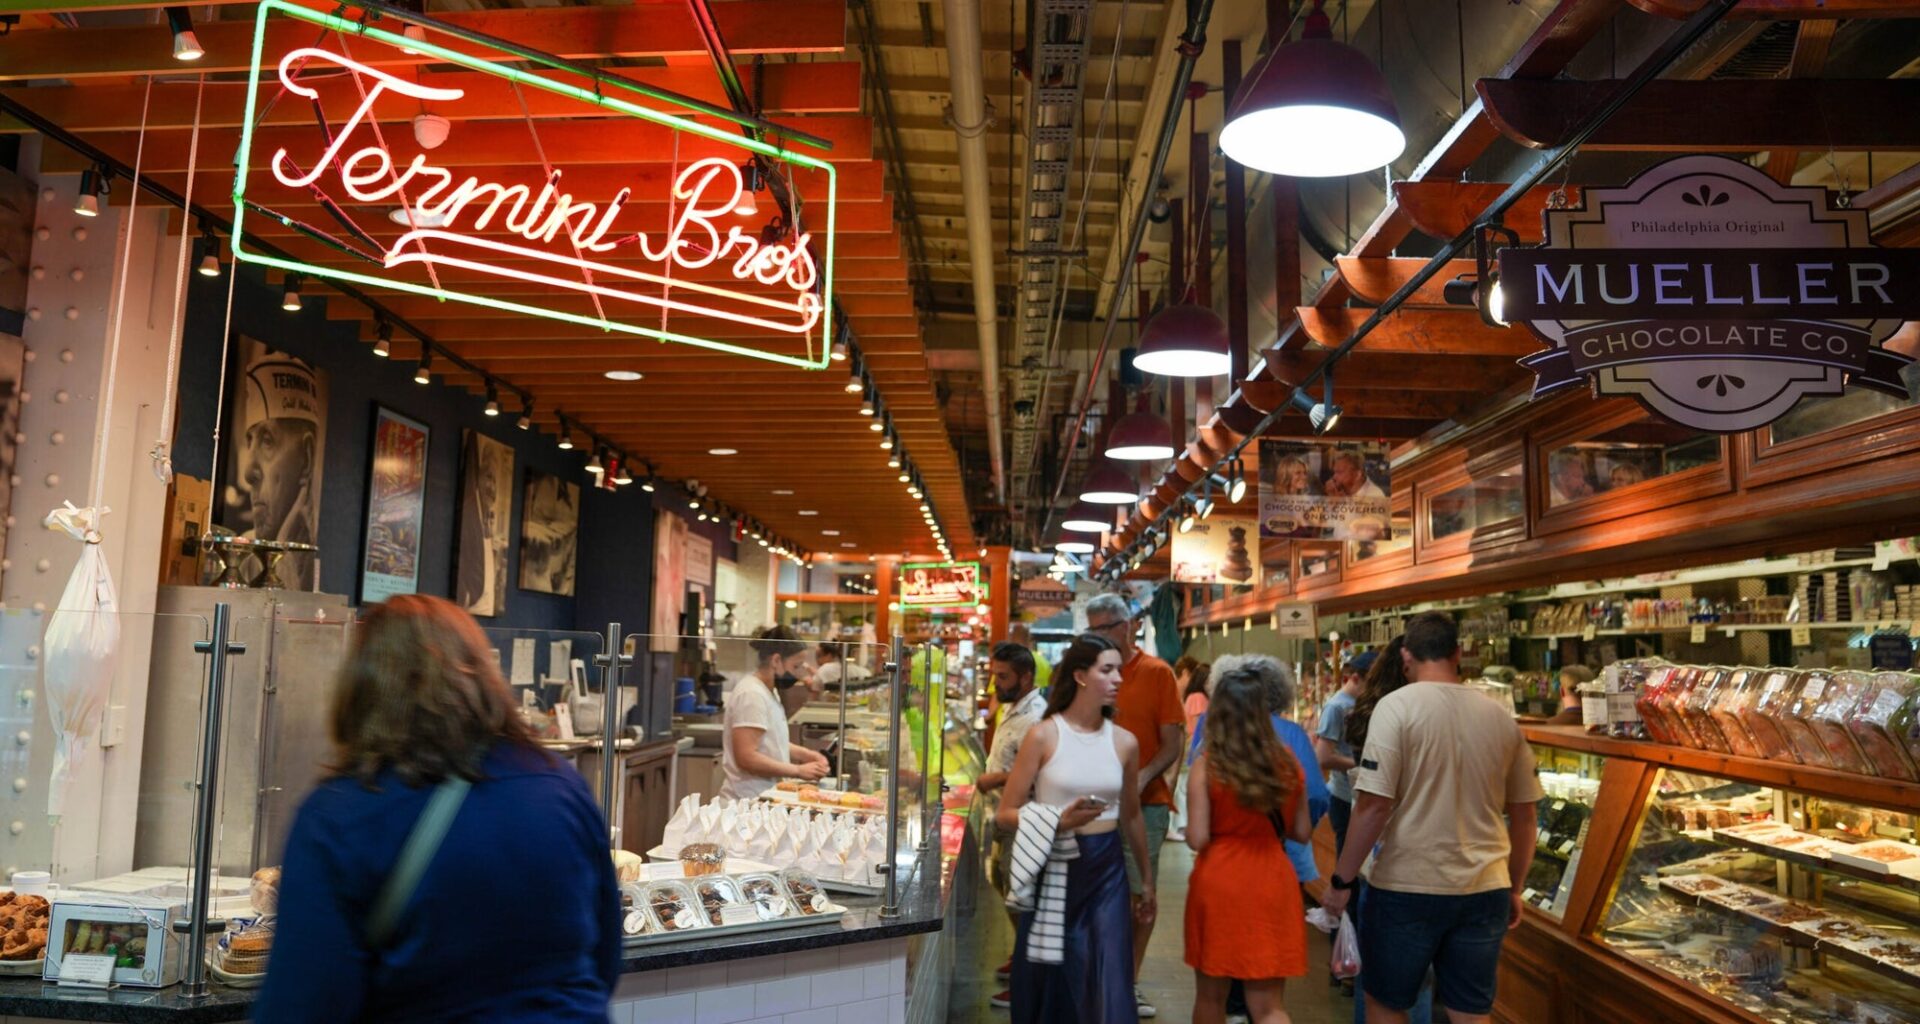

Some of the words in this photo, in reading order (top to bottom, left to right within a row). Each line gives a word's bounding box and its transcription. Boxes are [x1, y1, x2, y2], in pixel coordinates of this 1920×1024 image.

[272, 47, 631, 251] Termini
[638, 157, 817, 291] Bros
[1631, 220, 1721, 235] Philadelphia
[1725, 220, 1785, 235] Original
[1533, 262, 1894, 306] MUELLER
[1580, 325, 1788, 358] CHOCOLATE
[1801, 331, 1856, 359] CO.
[1264, 503, 1327, 513] CHOCOLATE
[1332, 506, 1386, 514] COVERED
[1303, 513, 1346, 521] ONIONS
[1017, 591, 1072, 601] MUELLER
